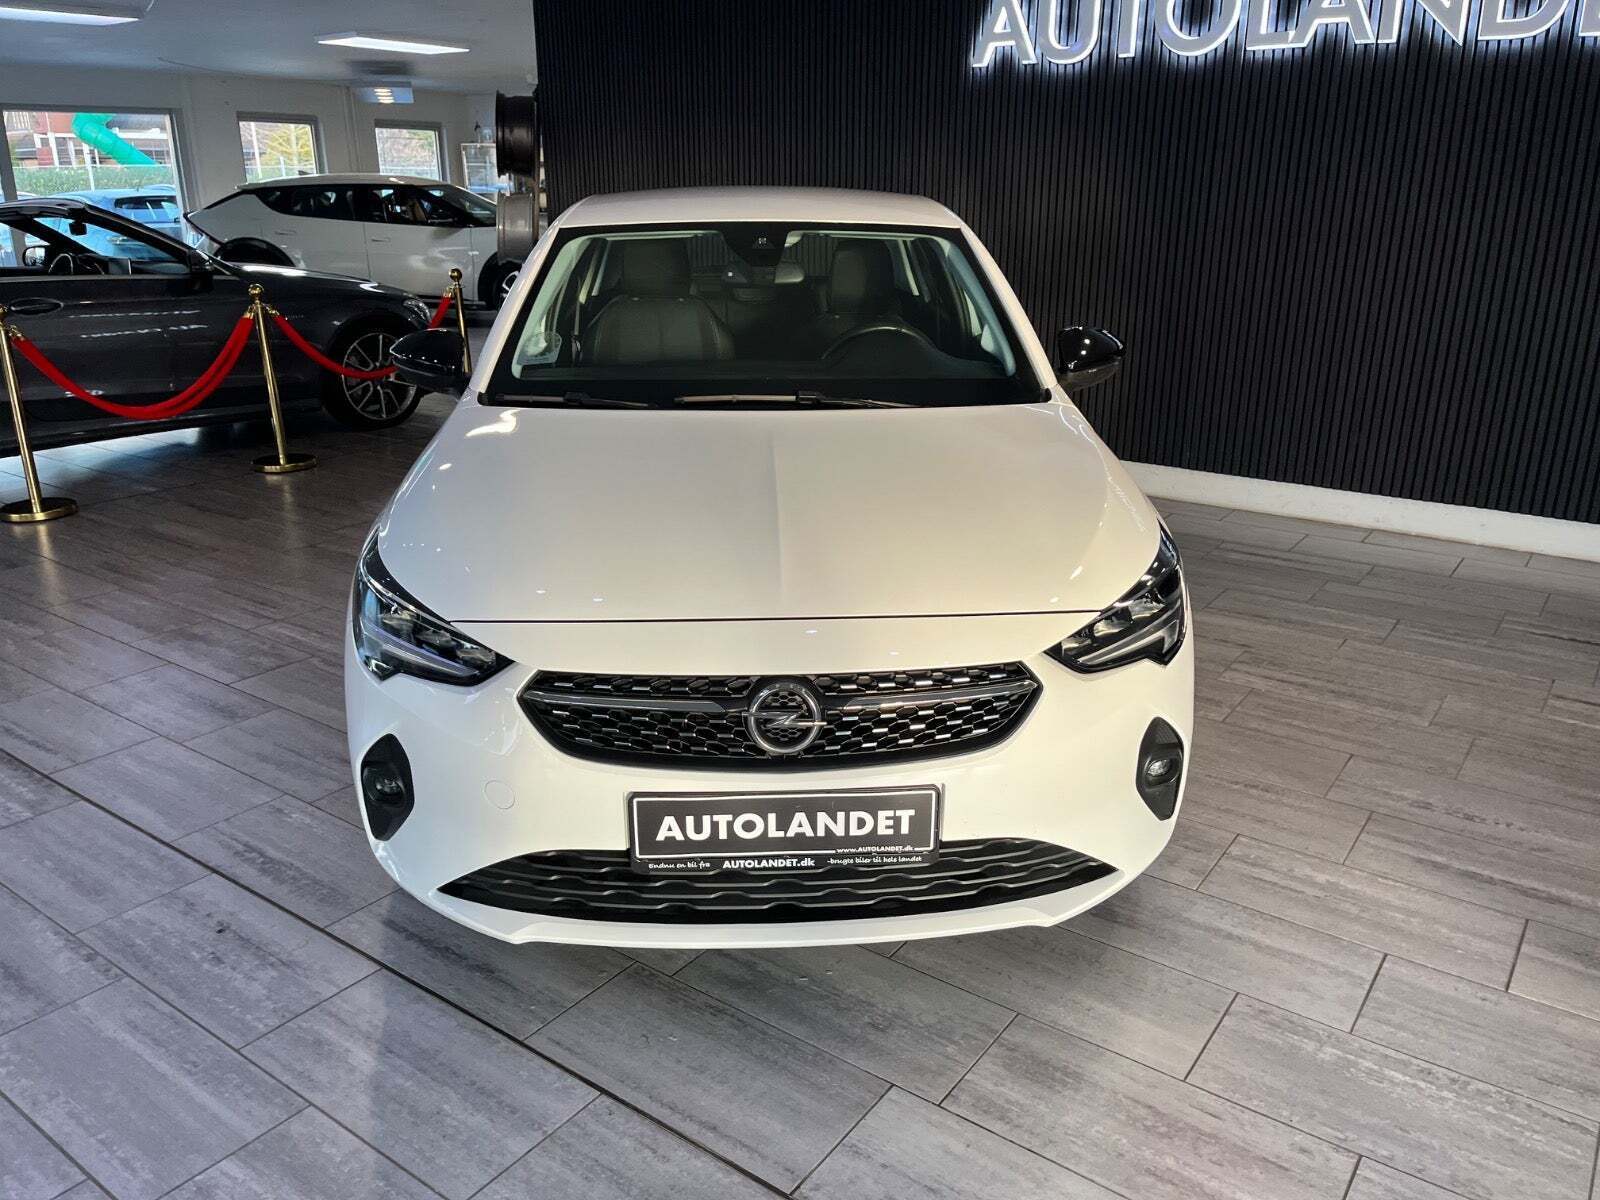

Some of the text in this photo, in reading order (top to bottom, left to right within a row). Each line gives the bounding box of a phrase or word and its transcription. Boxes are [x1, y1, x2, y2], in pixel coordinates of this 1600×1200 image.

[972, 0, 1600, 68] AUOLAND
[655, 809, 915, 841] AUTOLANDET
[836, 844, 914, 853] www.AUTOLANDET.dk
[687, 861, 698, 869] bil
[699, 860, 711, 870] fra
[722, 858, 815, 869] AUTOLANDET.dk
[855, 857, 871, 865] biler
[872, 855, 882, 863] til
[898, 855, 922, 863] landet
